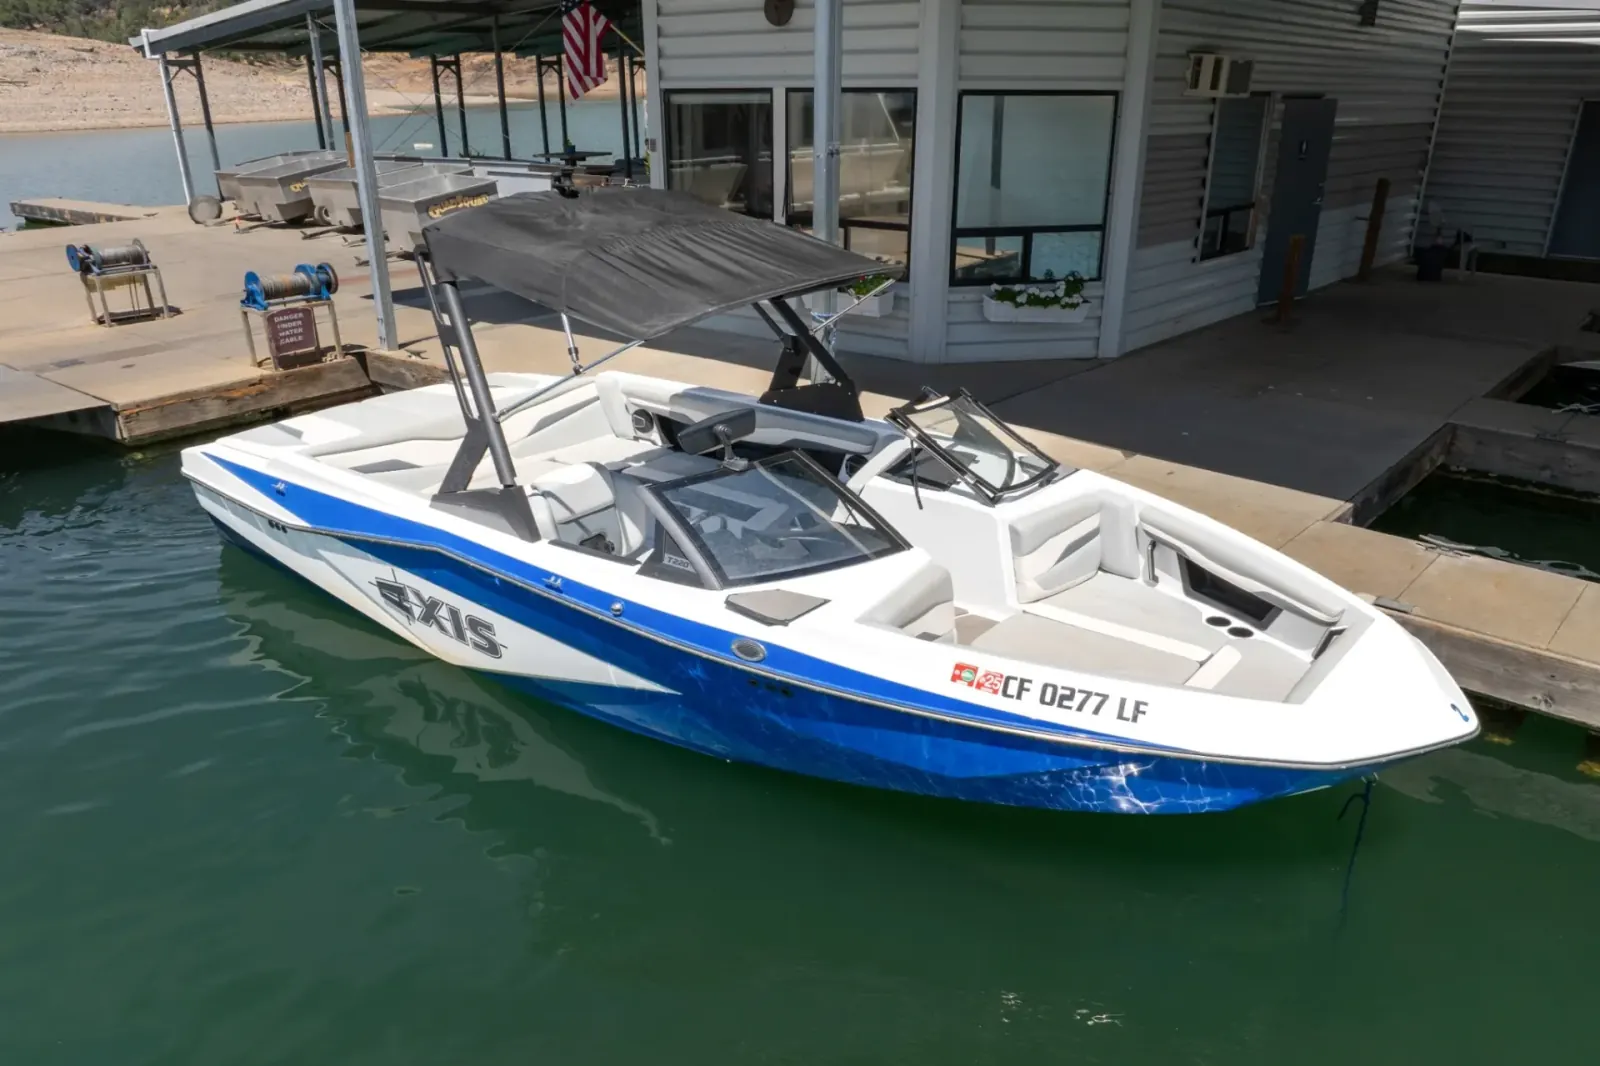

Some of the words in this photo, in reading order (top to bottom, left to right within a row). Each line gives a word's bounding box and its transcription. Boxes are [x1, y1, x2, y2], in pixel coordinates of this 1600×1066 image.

[274, 312, 304, 322] DANGER
[277, 320, 303, 329] UNDER
[279, 328, 304, 337] WATER
[280, 336, 304, 345] CABLE
[667, 556, 690, 568] T220
[372, 575, 504, 659] AXIS
[984, 674, 1002, 690] 25
[1001, 675, 1033, 701] CF
[1039, 682, 1110, 716] 0277
[1116, 697, 1149, 724] LF
